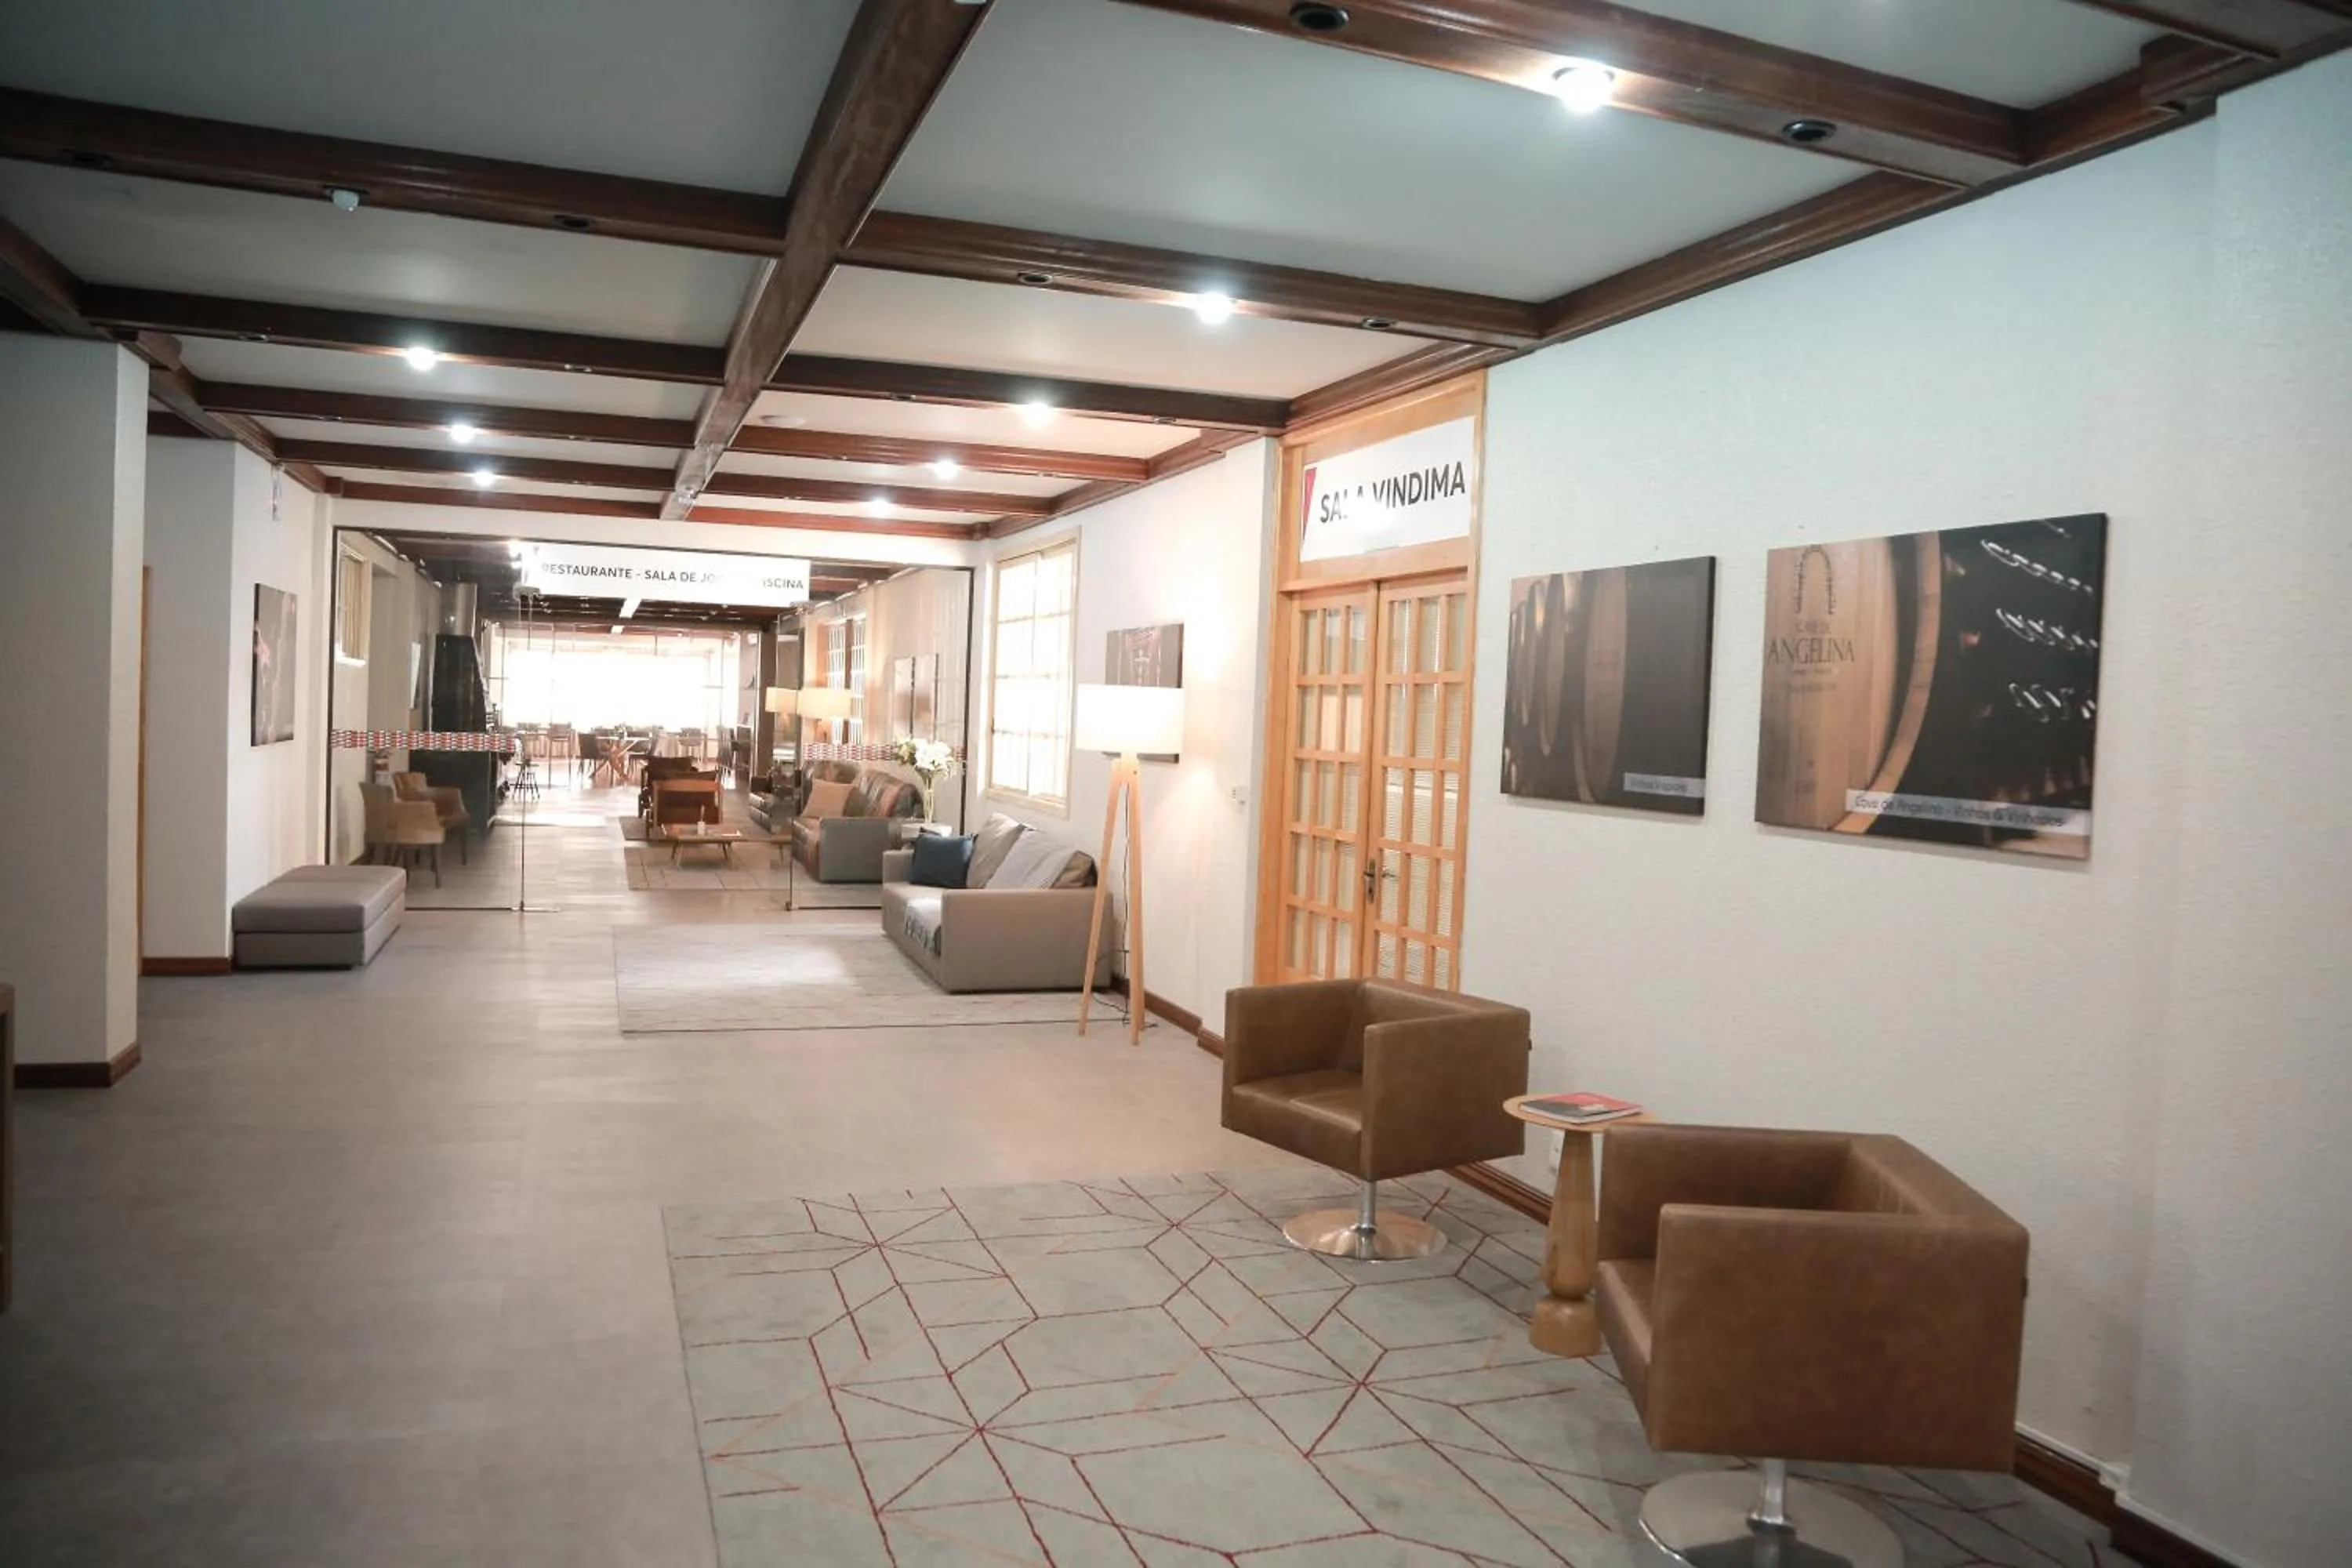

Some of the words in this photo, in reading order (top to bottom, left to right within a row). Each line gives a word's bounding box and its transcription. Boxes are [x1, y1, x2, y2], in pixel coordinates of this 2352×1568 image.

[1319, 485, 1367, 523] SA
[1372, 460, 1466, 510] VINDIMA
[644, 569, 677, 582] SALA
[680, 572, 696, 583] DE
[758, 576, 804, 590] ISCINA
[1768, 637, 1855, 665] ANGELINA
